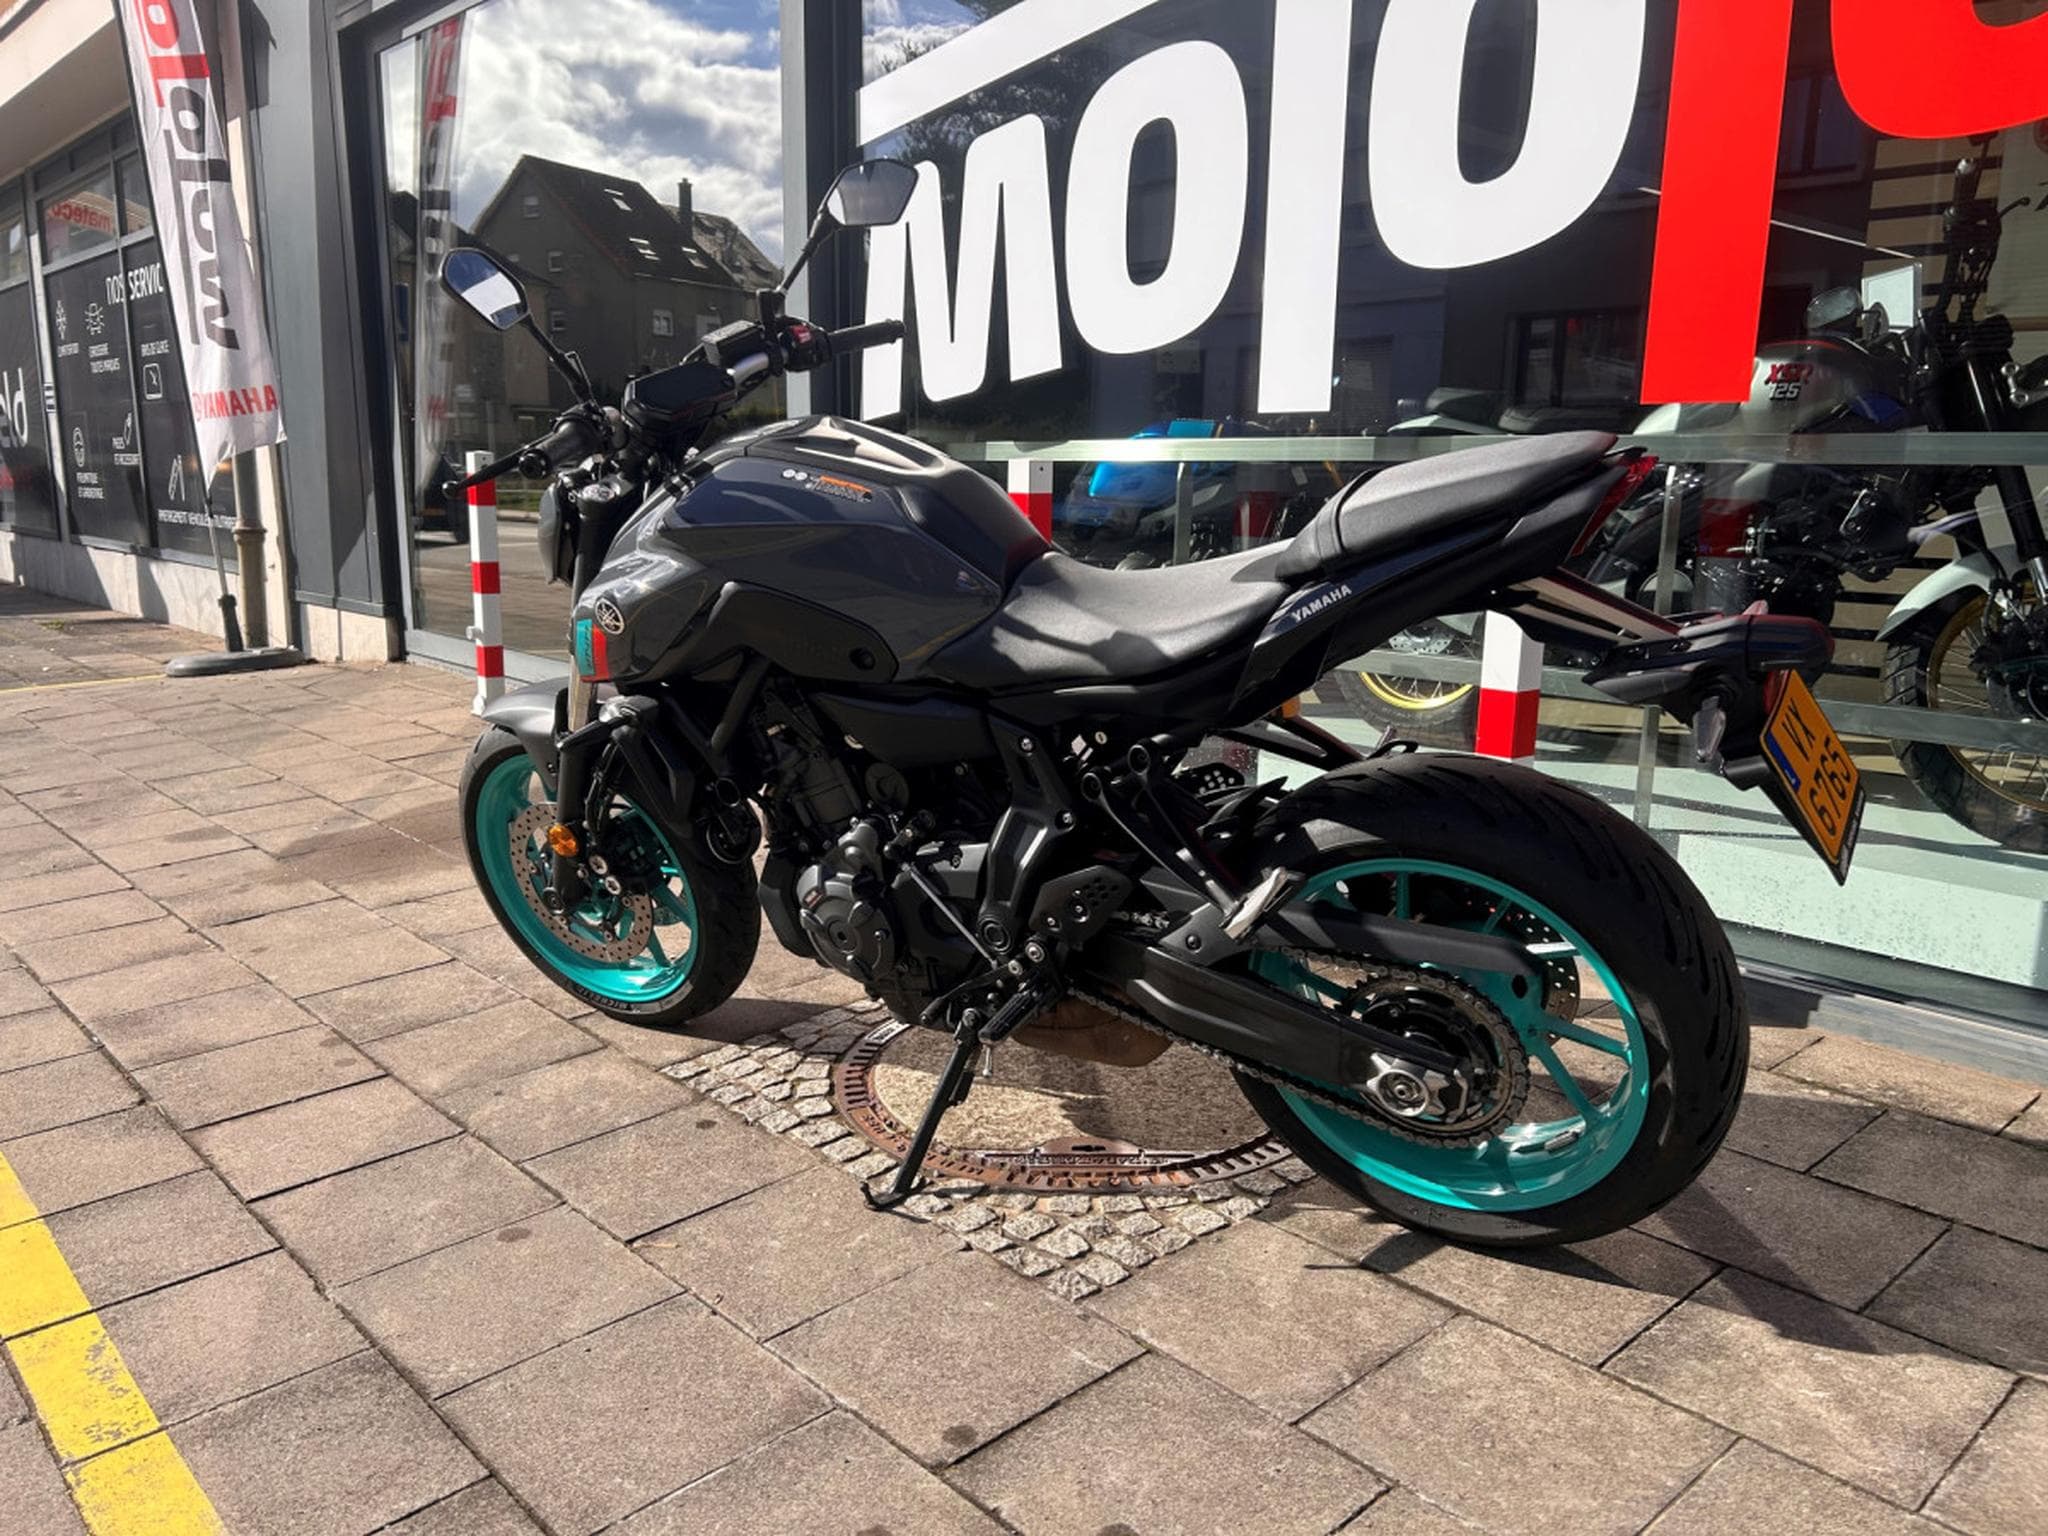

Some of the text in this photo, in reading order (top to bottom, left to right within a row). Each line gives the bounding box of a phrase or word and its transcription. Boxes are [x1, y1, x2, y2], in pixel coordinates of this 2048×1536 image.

[1768, 381, 1802, 400] 125
[1291, 584, 1353, 622] YAMAHA
[1808, 736, 1853, 838] 6765
